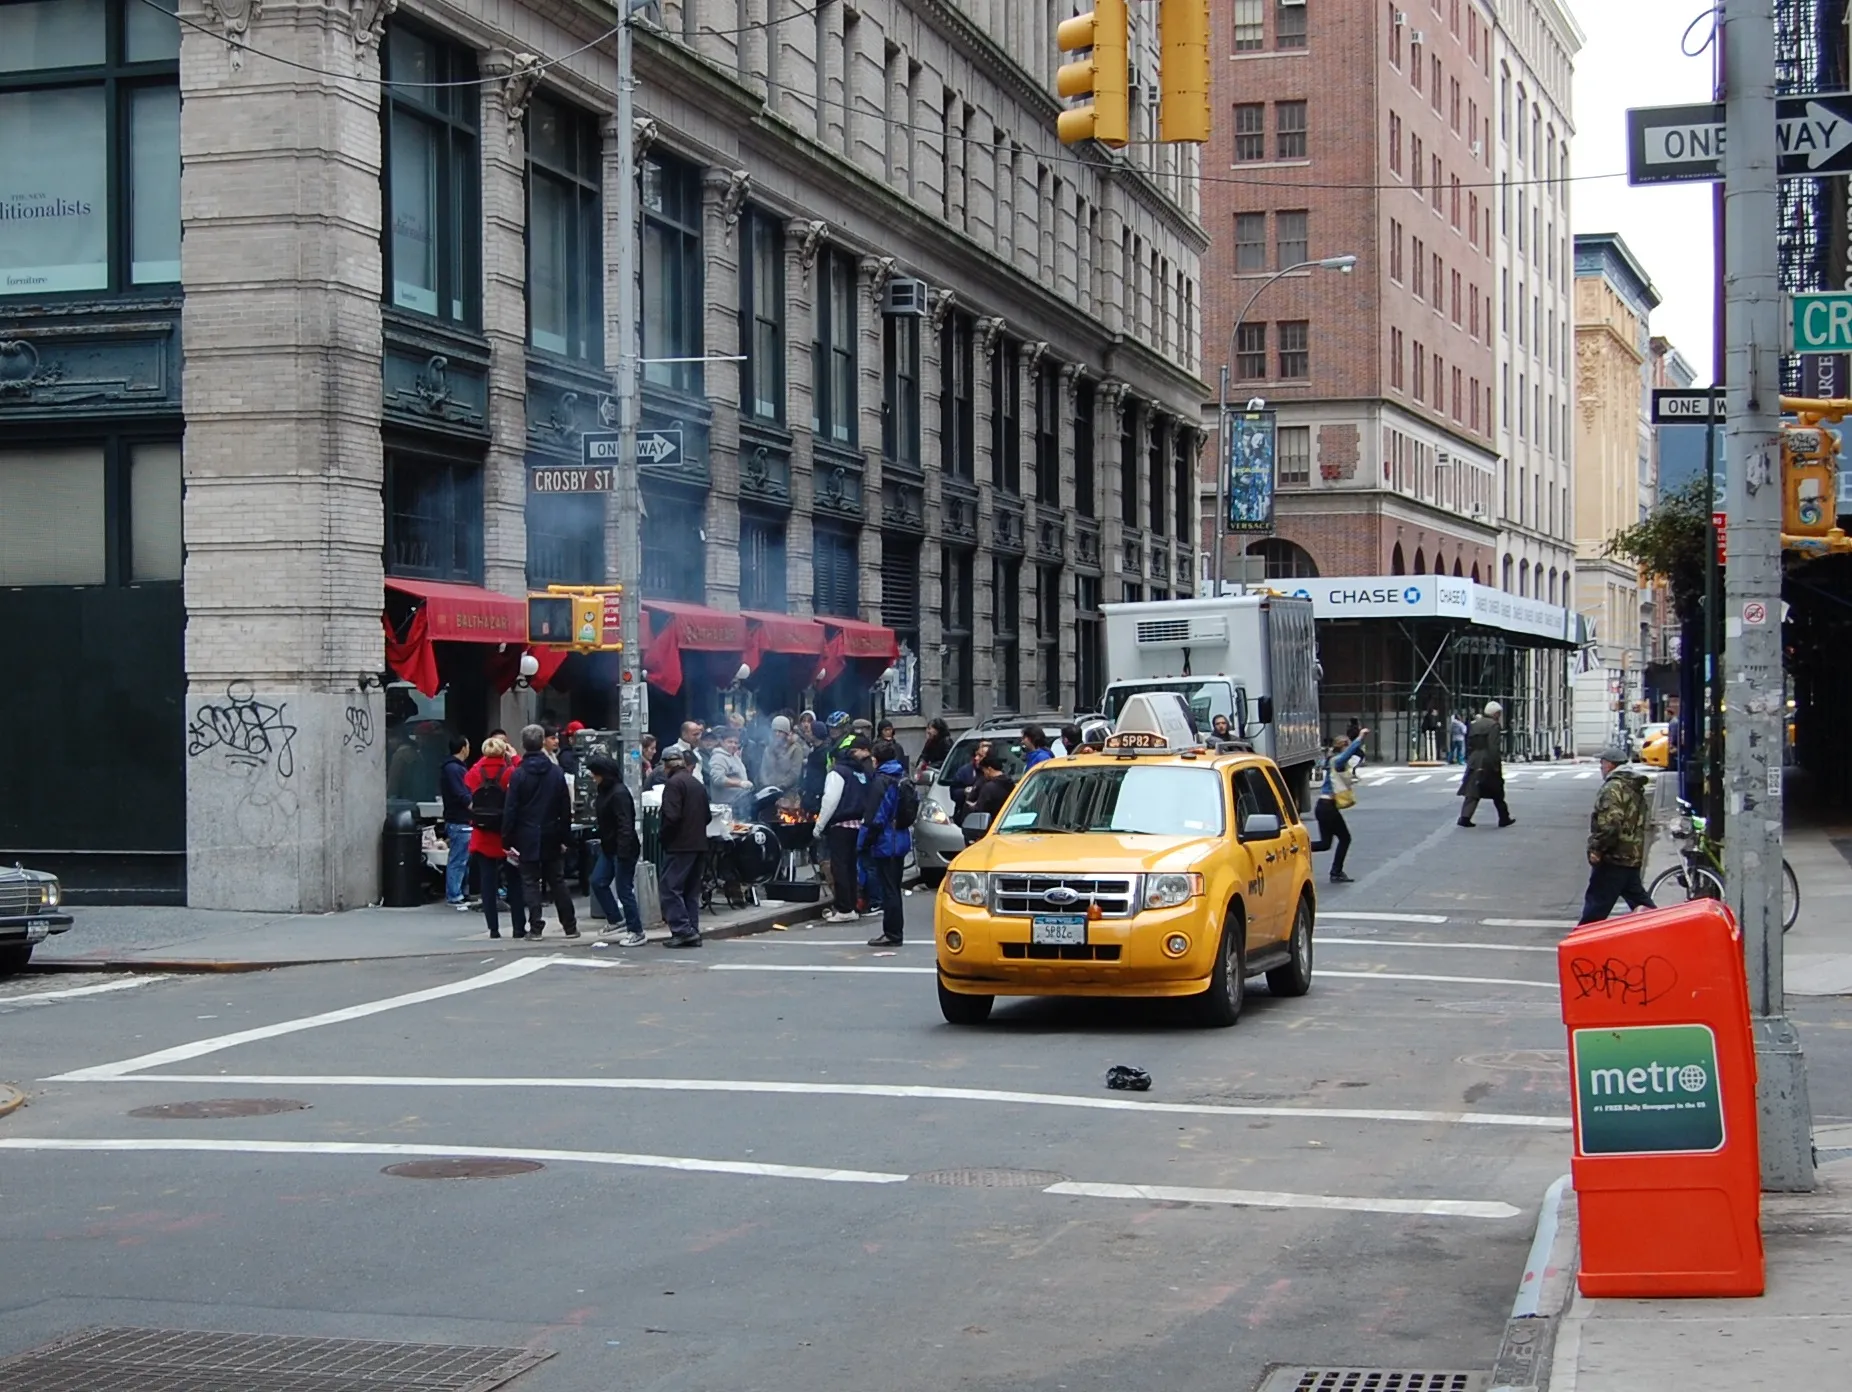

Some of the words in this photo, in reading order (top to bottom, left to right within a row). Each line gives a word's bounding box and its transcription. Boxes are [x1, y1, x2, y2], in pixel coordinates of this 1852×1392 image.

[1668, 399, 1701, 413] ONE
[597, 443, 619, 456] ON
[637, 441, 667, 455] WAY
[535, 470, 587, 491] CROSBY
[594, 469, 610, 490] ST
[1330, 589, 1399, 604] CHASE
[1439, 588, 1461, 605] CHASE
[1122, 735, 1150, 747] 5P82
[1590, 1061, 1707, 1096] metro
[1604, 1104, 1623, 1112] FREE
[1624, 1103, 1641, 1112] Daily
[1642, 1103, 1676, 1111] Newspaper
[1685, 1101, 1696, 1109] the
